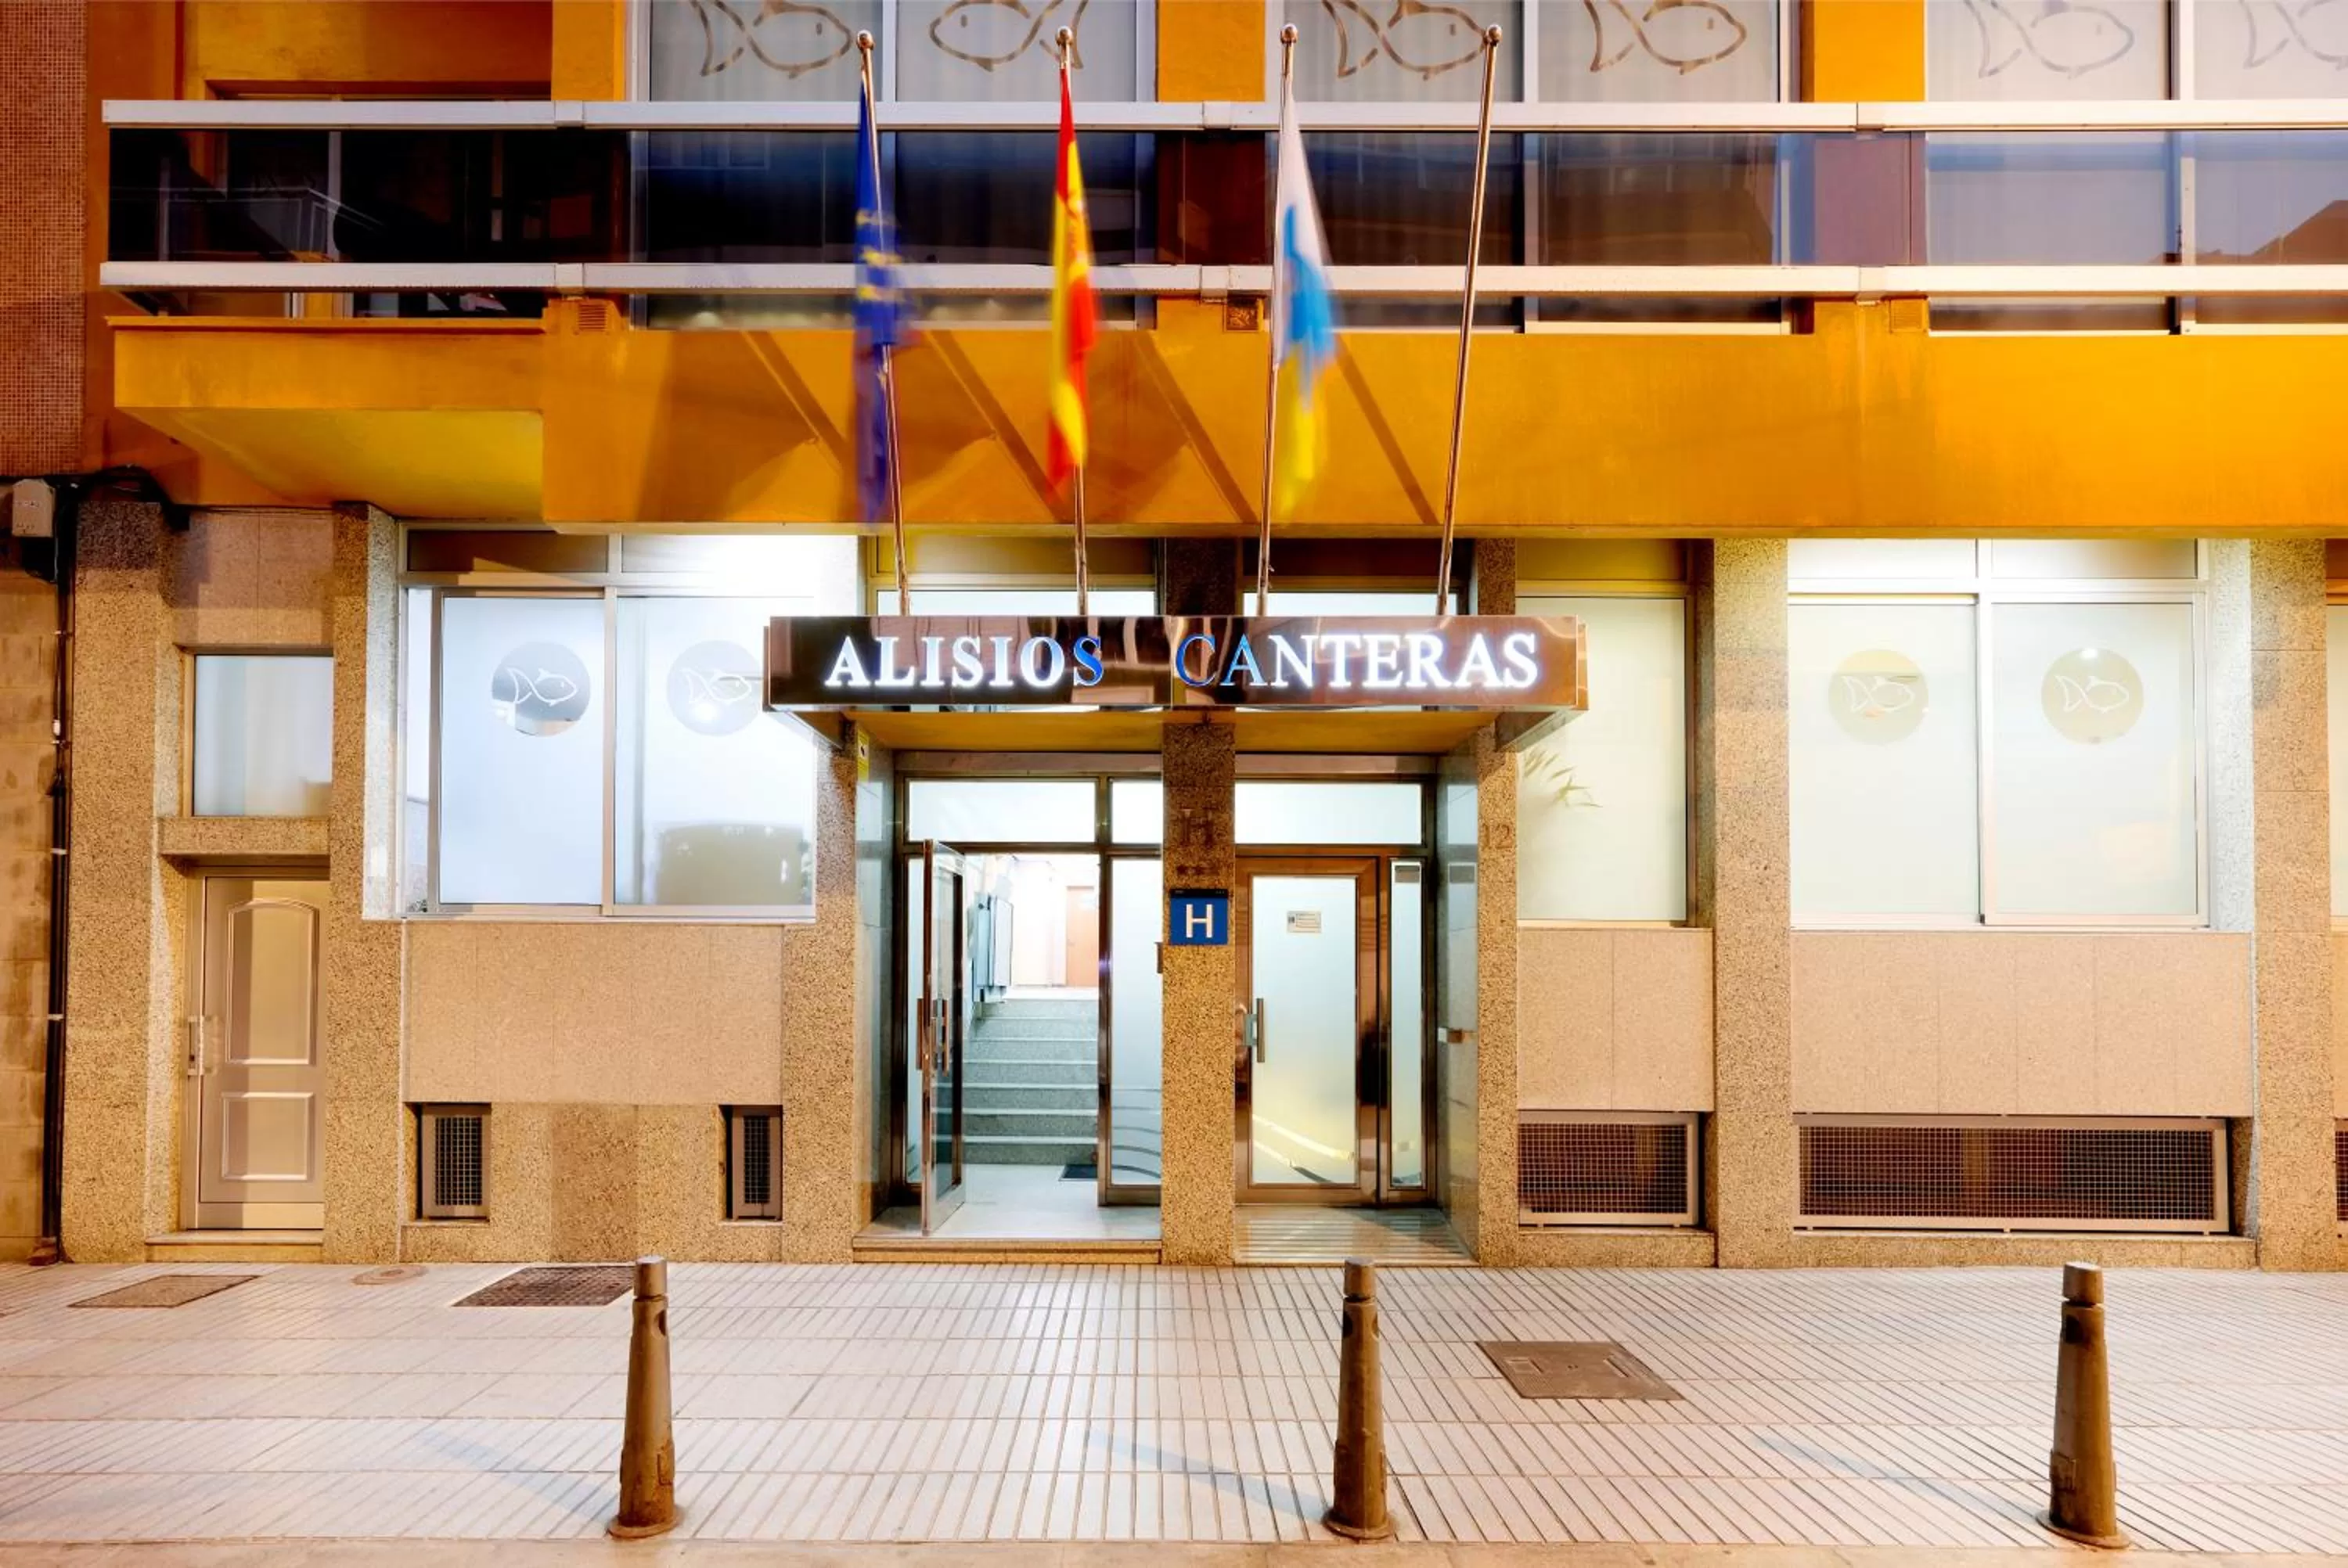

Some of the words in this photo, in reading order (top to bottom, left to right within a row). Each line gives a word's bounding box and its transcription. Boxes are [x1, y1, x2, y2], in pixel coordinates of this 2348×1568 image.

[824, 635, 1104, 687] ALISIOS
[1175, 632, 1539, 687] CANTERAS
[1482, 822, 1512, 851] 12
[1186, 904, 1212, 937] H
